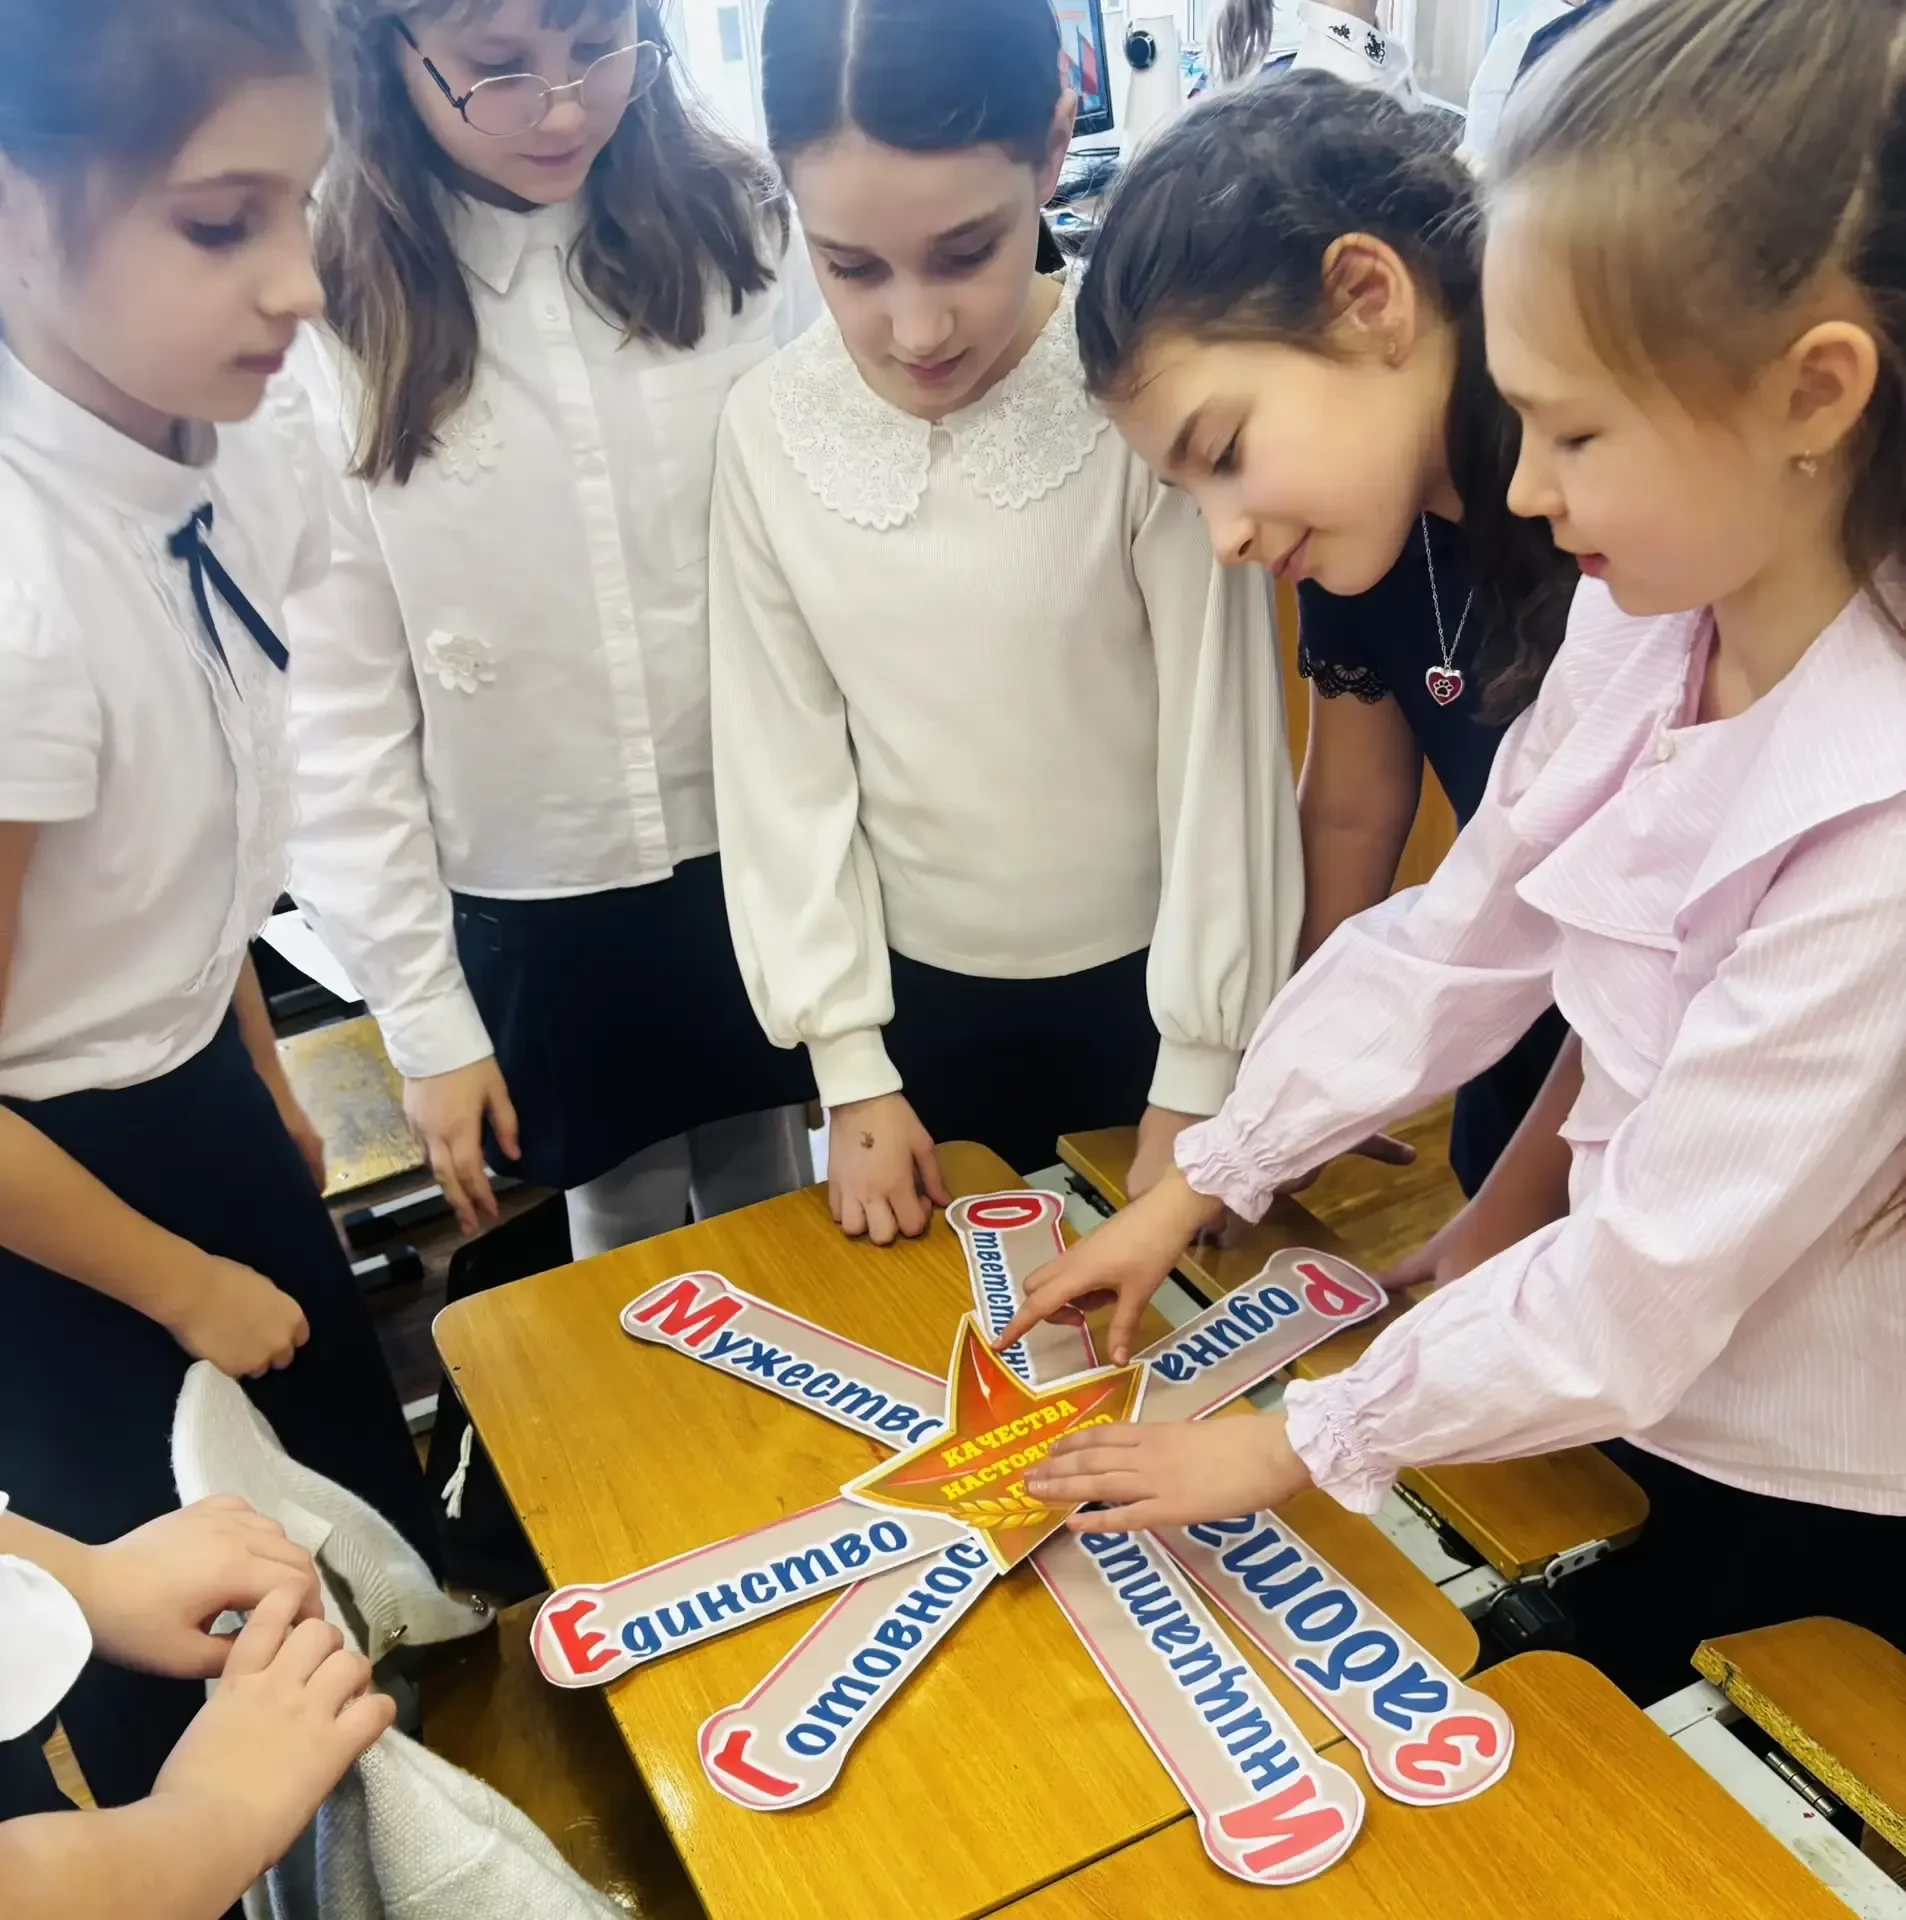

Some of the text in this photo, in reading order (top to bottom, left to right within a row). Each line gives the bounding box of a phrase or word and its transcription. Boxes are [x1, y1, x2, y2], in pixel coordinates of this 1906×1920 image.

[1151, 1263, 1375, 1380] Родина
[941, 1399, 1078, 1468] КАЧЕСТВА
[941, 1413, 1113, 1500] НАСТОЯ
[548, 1520, 908, 1674] Единство
[714, 1543, 989, 1797] Готовнос
